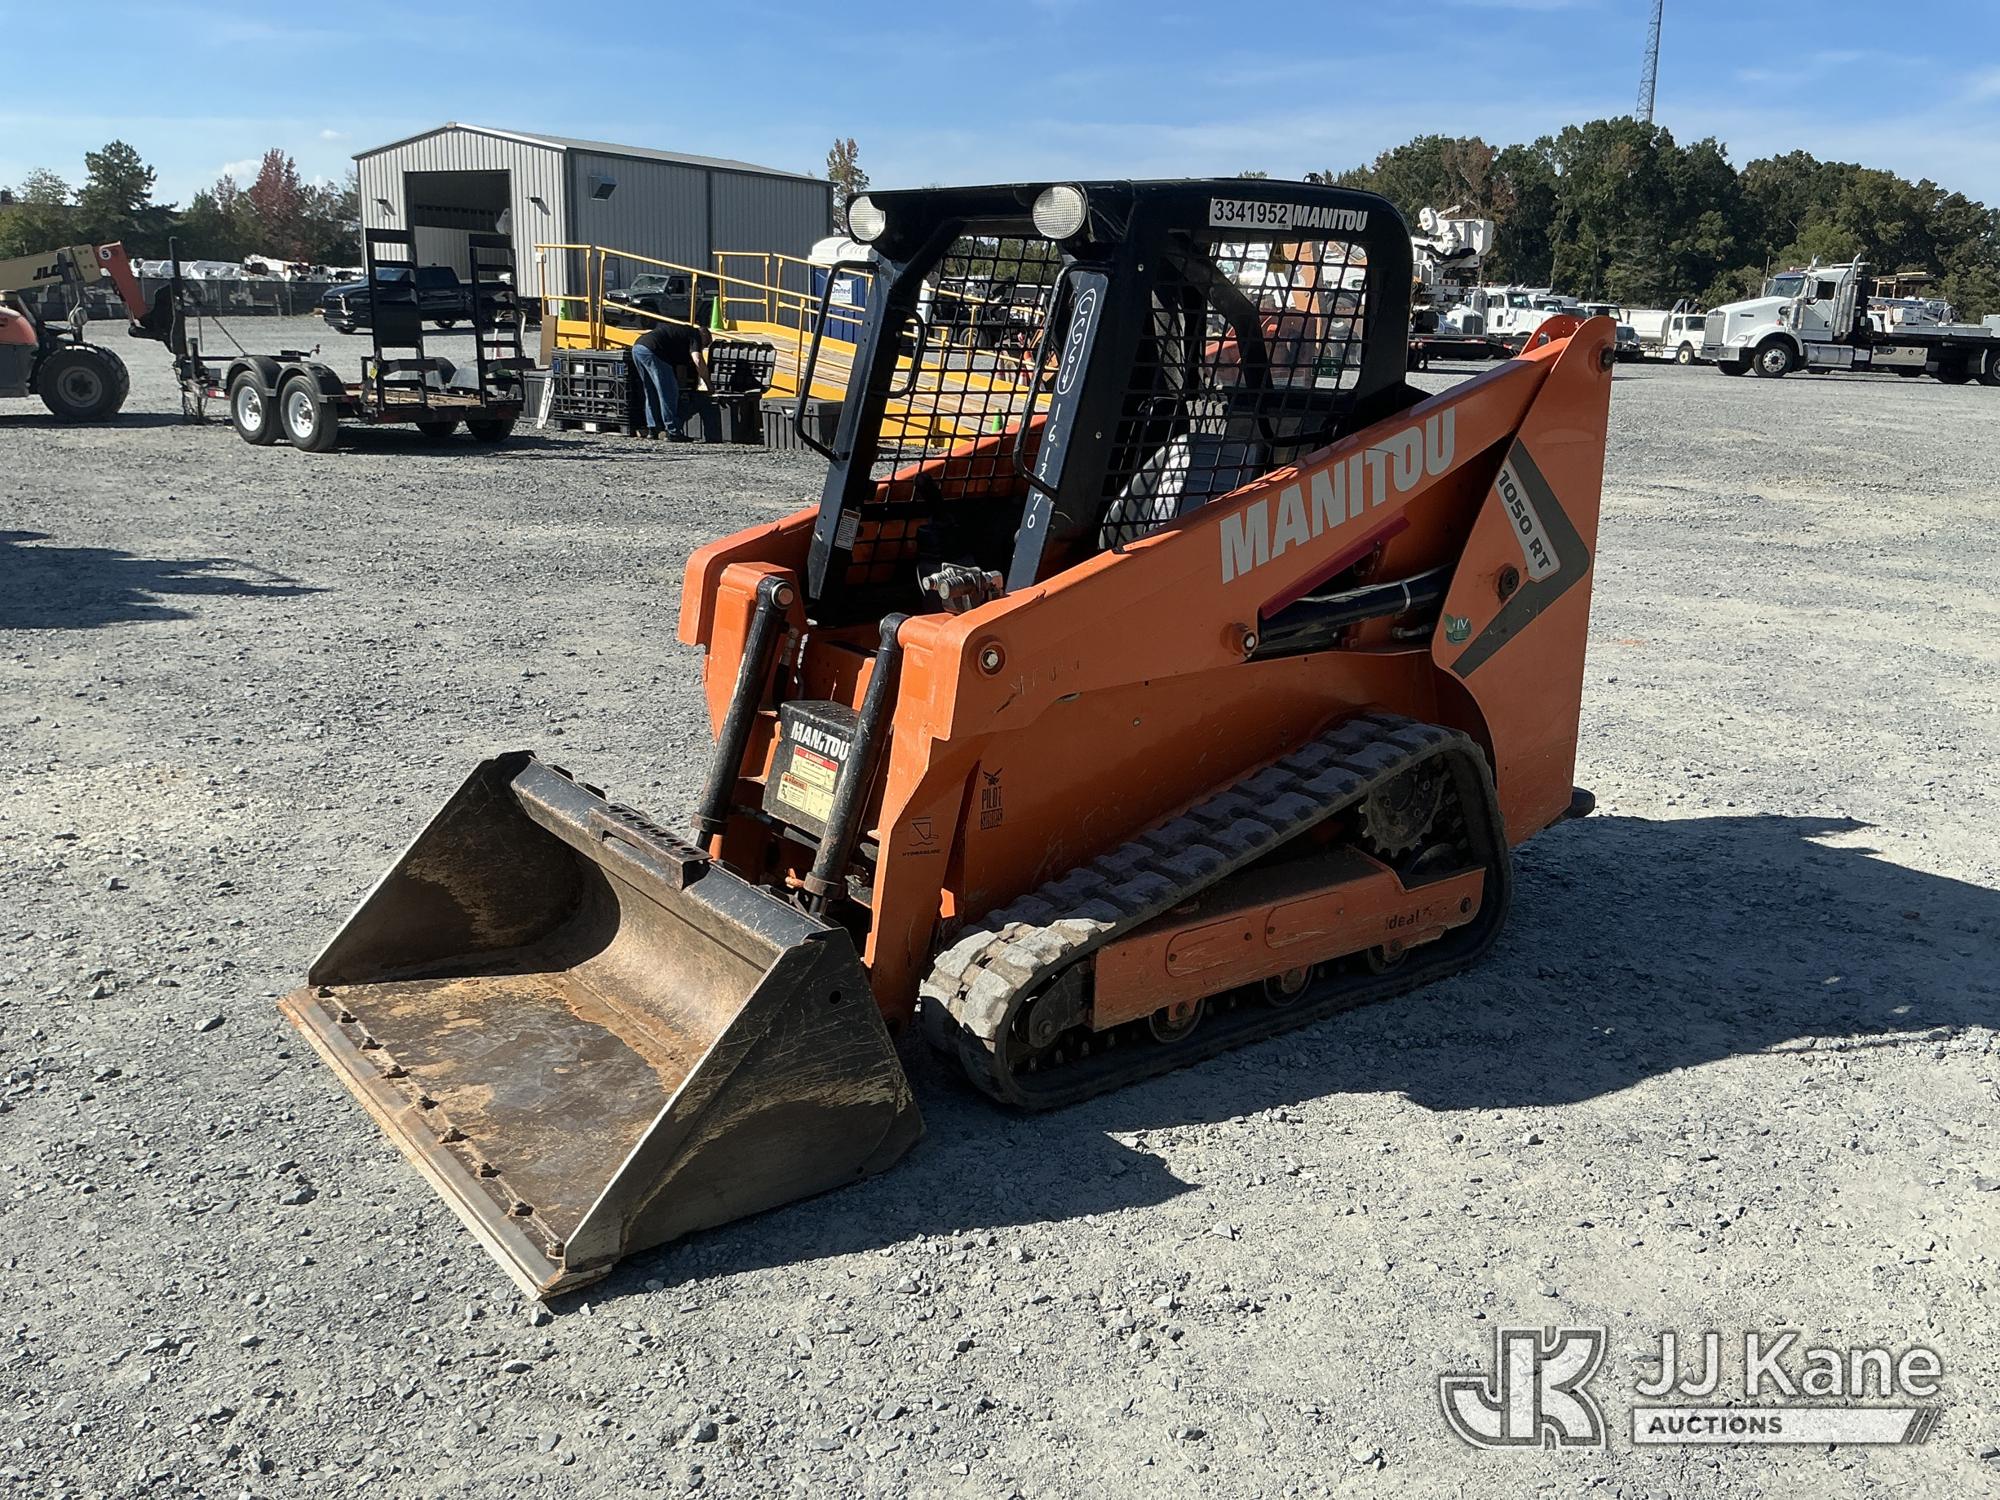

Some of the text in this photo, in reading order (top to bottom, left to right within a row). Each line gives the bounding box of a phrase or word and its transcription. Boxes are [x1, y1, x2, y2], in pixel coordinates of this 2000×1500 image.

[1213, 200, 1288, 224] 3341952
[1292, 205, 1369, 232] MANITOU
[1220, 406, 1456, 585] MANITOU
[1498, 469, 1551, 569] 1050 RT
